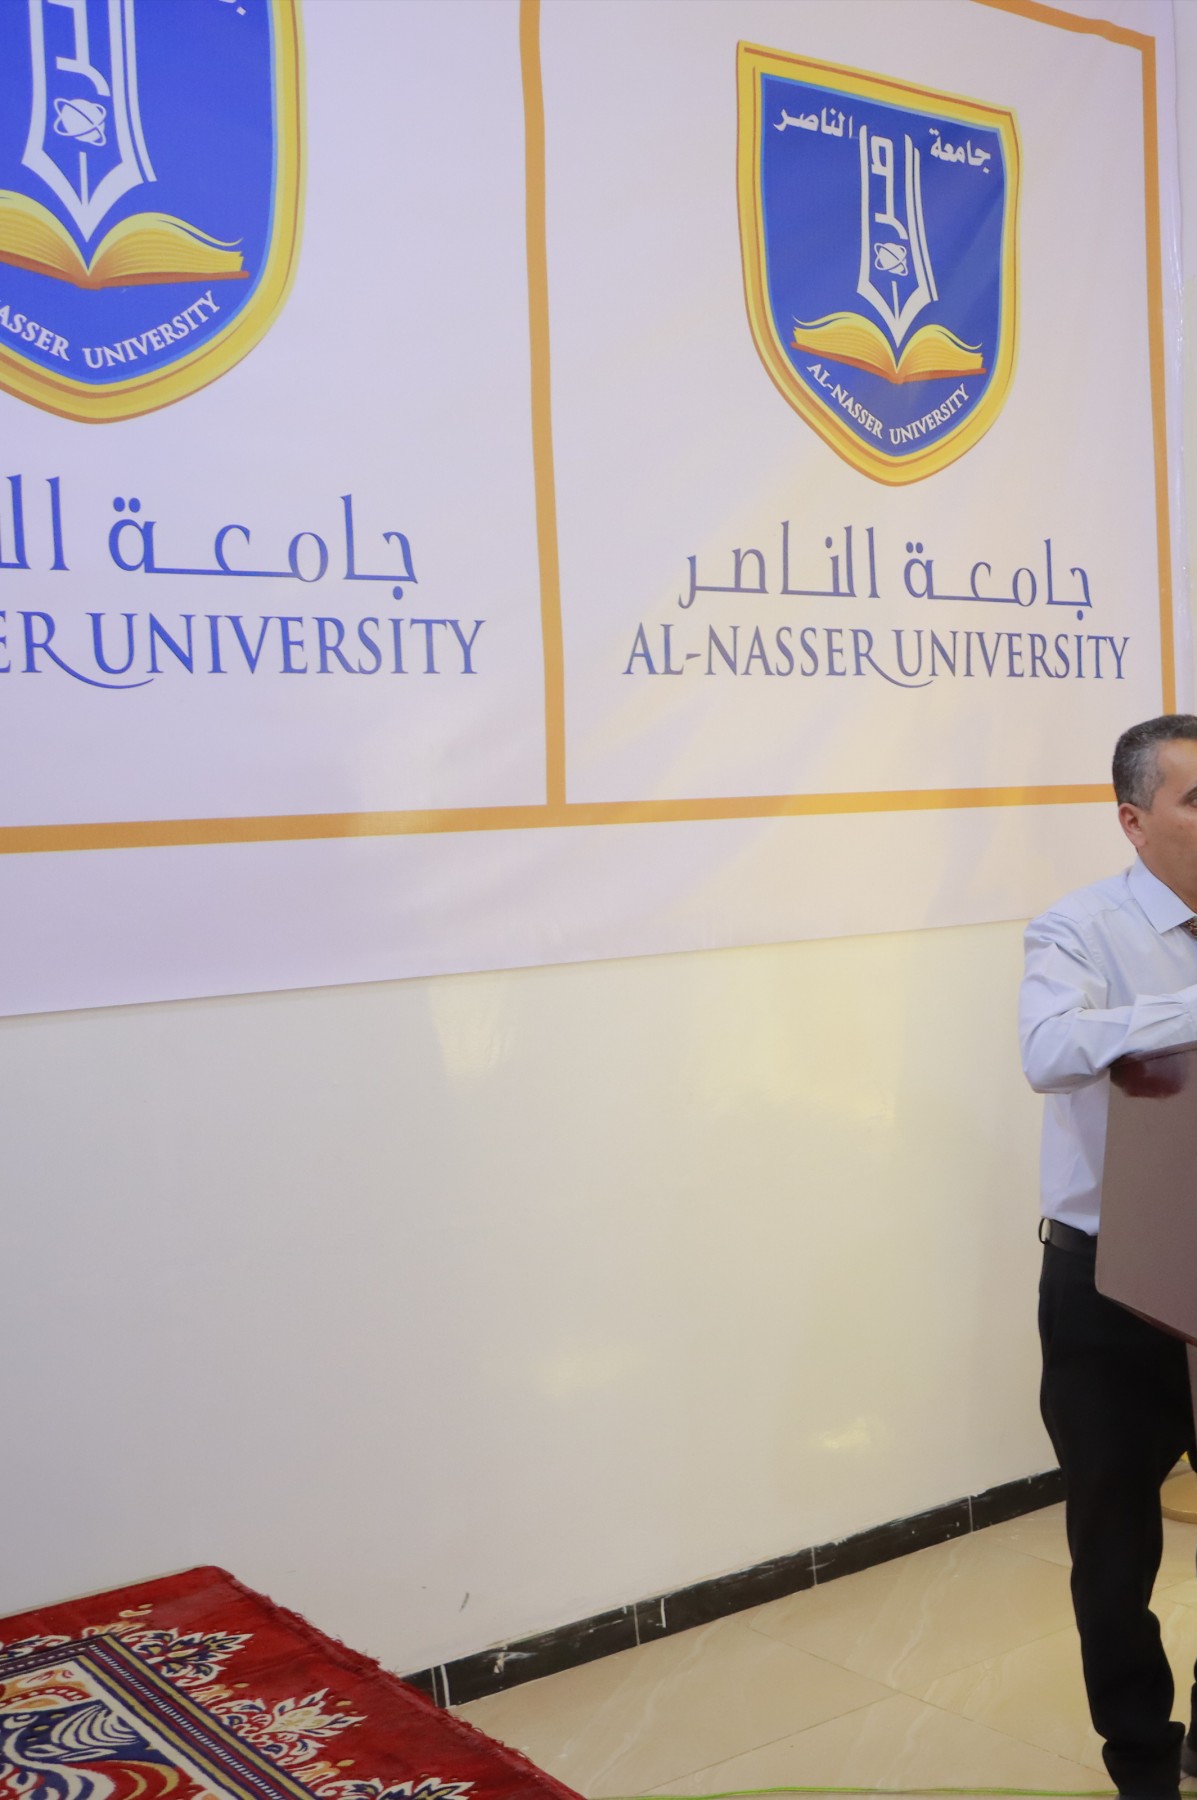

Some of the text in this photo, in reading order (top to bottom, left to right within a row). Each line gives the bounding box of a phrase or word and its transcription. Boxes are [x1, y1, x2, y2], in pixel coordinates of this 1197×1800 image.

[773, 107, 991, 174] جامعة الناصر
[82, 290, 220, 368] UNIVERSITY
[806, 363, 969, 444] AL-NASSER UNIVERSITY
[108, 494, 418, 601] جامعة
[677, 520, 1094, 621] جامعة الناصر
[85, 612, 486, 676] UNIVERSITY
[621, 621, 1130, 688] AL-NASSER UNIVERSITY
